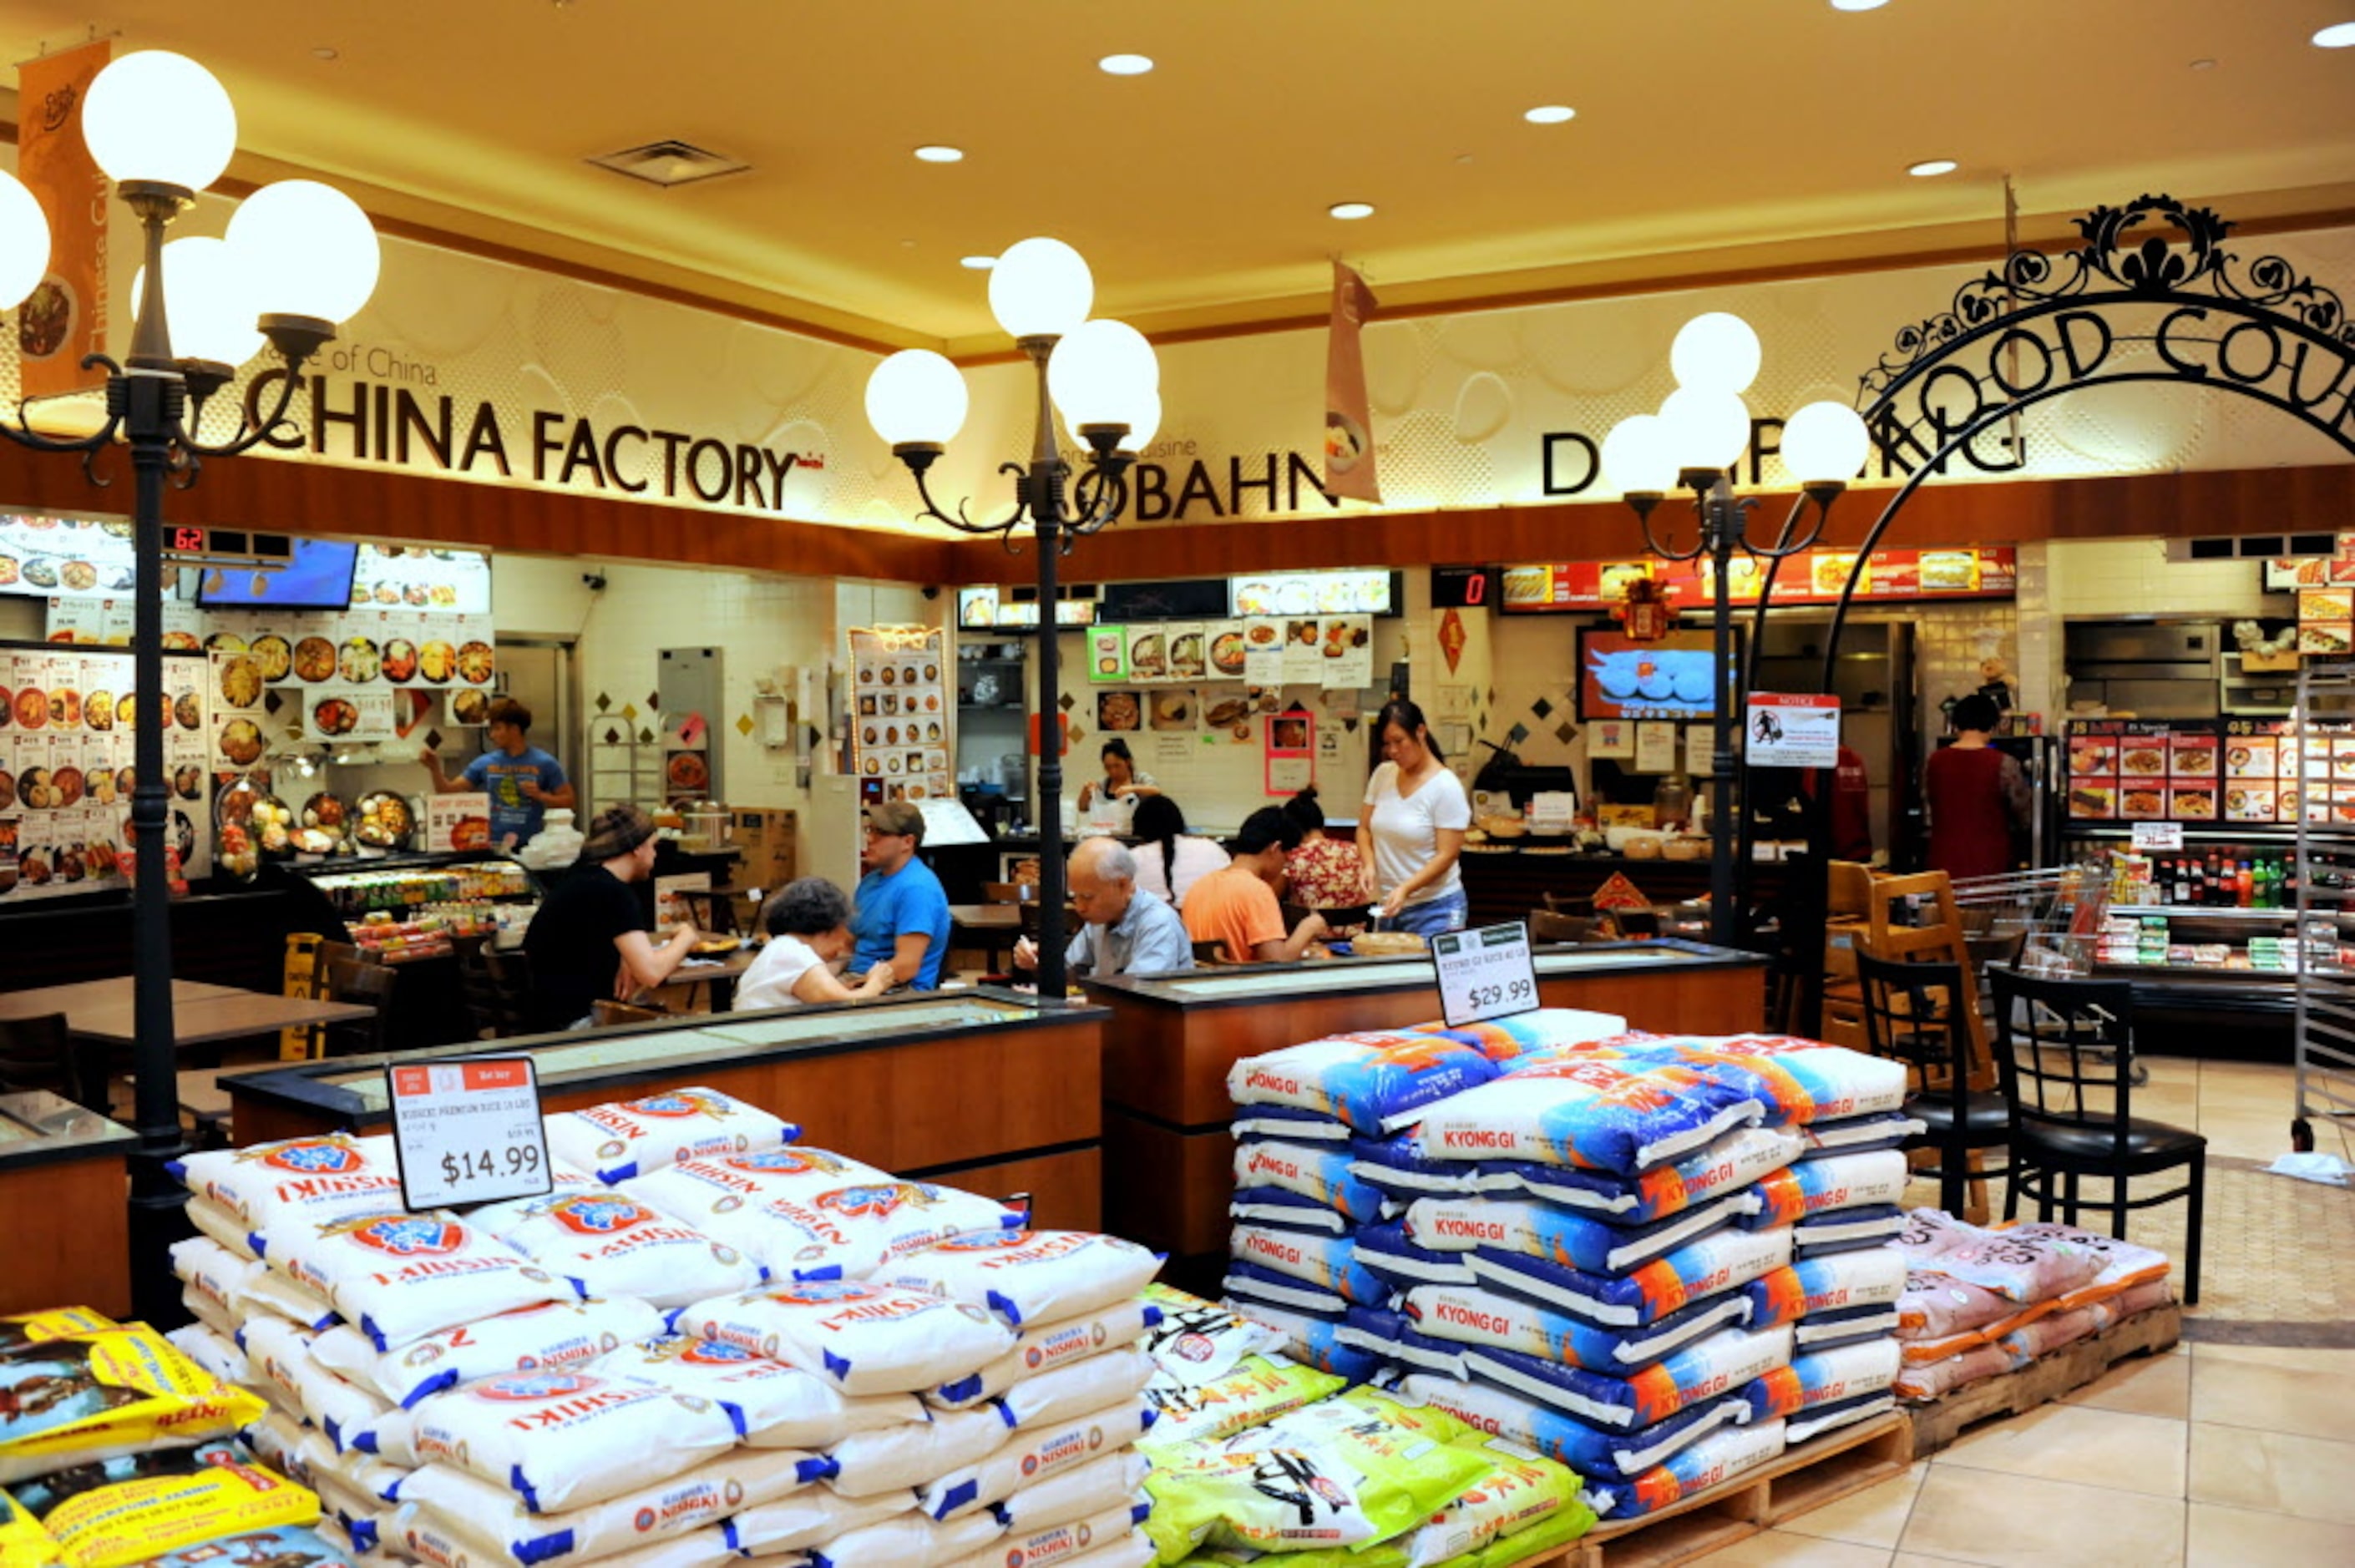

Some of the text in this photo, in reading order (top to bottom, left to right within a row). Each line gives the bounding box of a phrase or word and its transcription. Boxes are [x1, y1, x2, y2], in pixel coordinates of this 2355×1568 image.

[332, 344, 361, 372] of
[367, 347, 437, 386] China
[245, 367, 797, 511] CHINA FACTORY
[174, 527, 203, 551] 62
[1466, 574, 1486, 604] 0
[1778, 695, 1816, 707] NOTICE
[1468, 979, 1531, 1010] $29.99
[1443, 1130, 1517, 1149] KYONG GI
[441, 1144, 539, 1188] $14.99
[1667, 1162, 1734, 1202] KYONG GI
[1434, 1218, 1505, 1242] KYONG GI
[1245, 1234, 1300, 1265] KYONG GI
[1715, 1266, 1730, 1286] GI
[1436, 1302, 1510, 1336] KYONG GI
[1046, 1335, 1090, 1359] NISHIKI
[1713, 1373, 1729, 1393] GI
[1041, 1438, 1085, 1464] NISHIKI
[1026, 1535, 1073, 1561] NISHIKI
